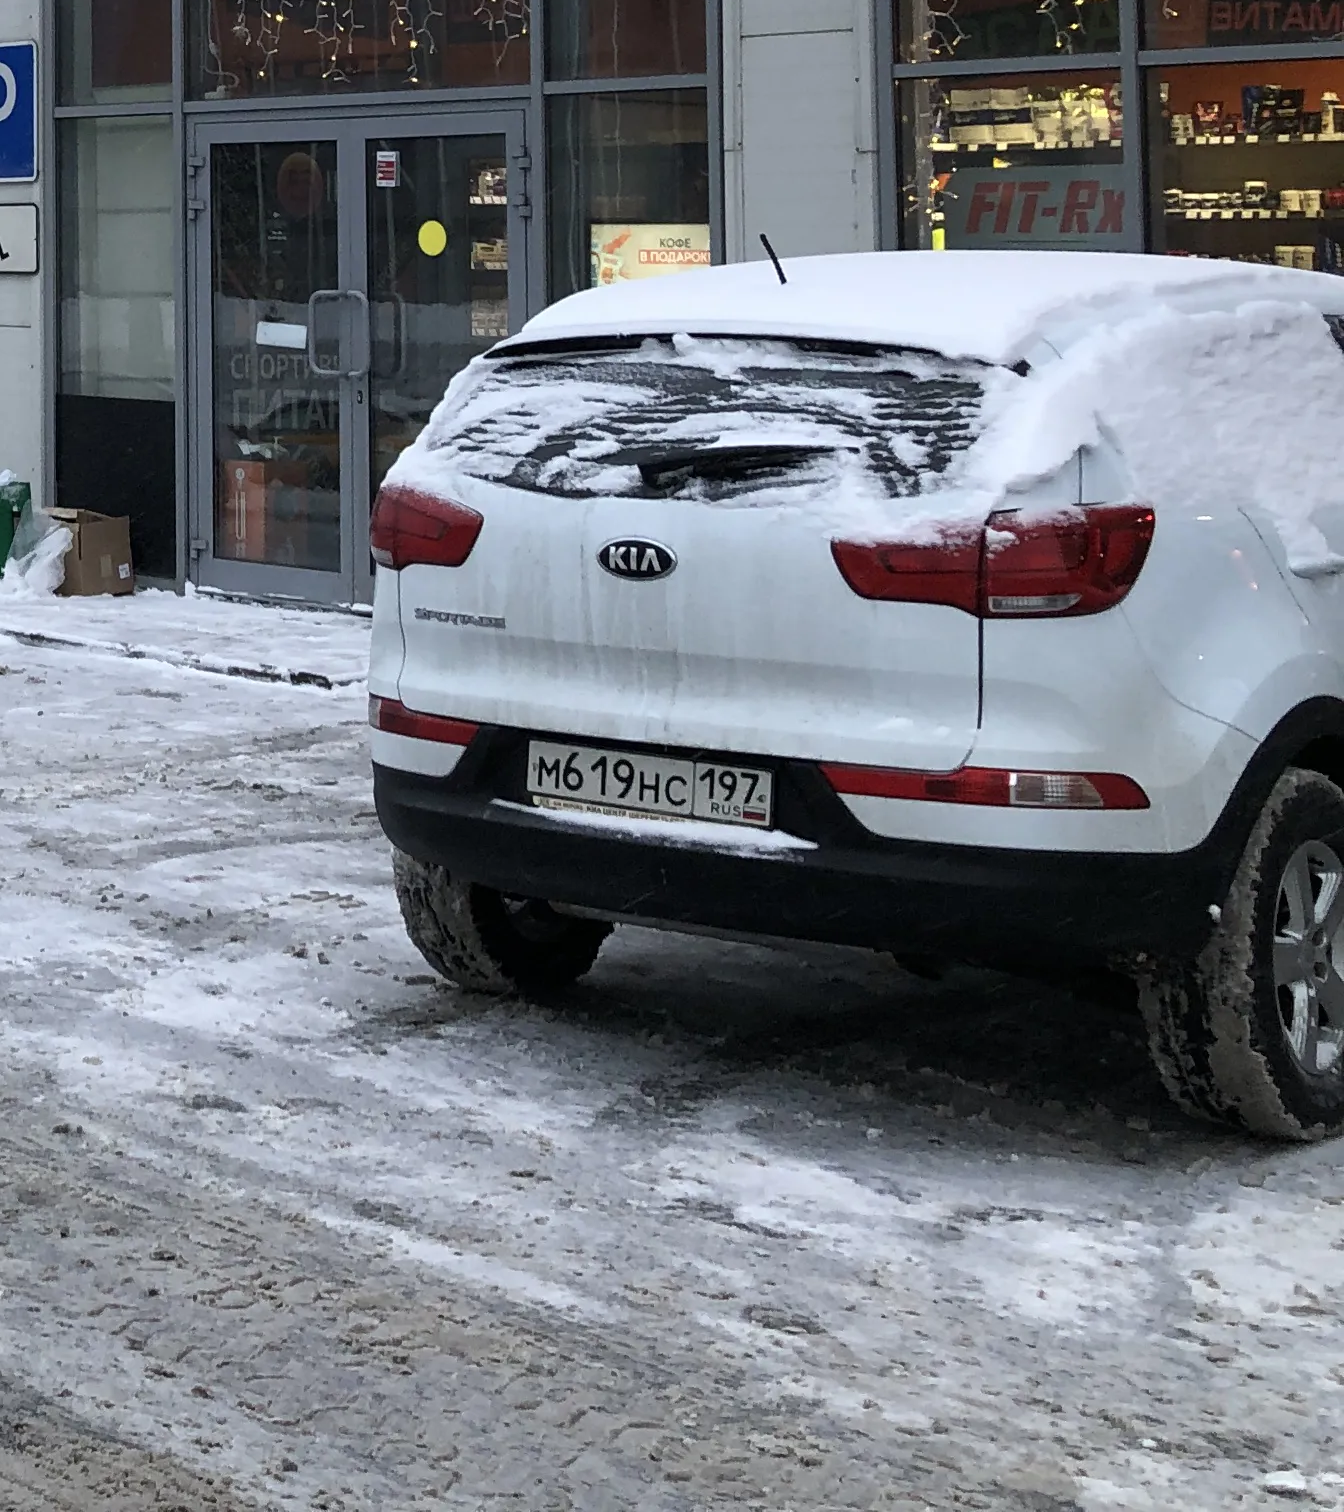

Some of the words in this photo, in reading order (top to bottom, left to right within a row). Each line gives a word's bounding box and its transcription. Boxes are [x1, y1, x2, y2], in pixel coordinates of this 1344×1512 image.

[1211, 0, 1344, 32] ВИТАМ
[659, 238, 691, 248] КОФЕ
[640, 251, 648, 262] В
[608, 546, 662, 572] KIA
[699, 768, 760, 804] 197
[711, 801, 742, 817] RUS
